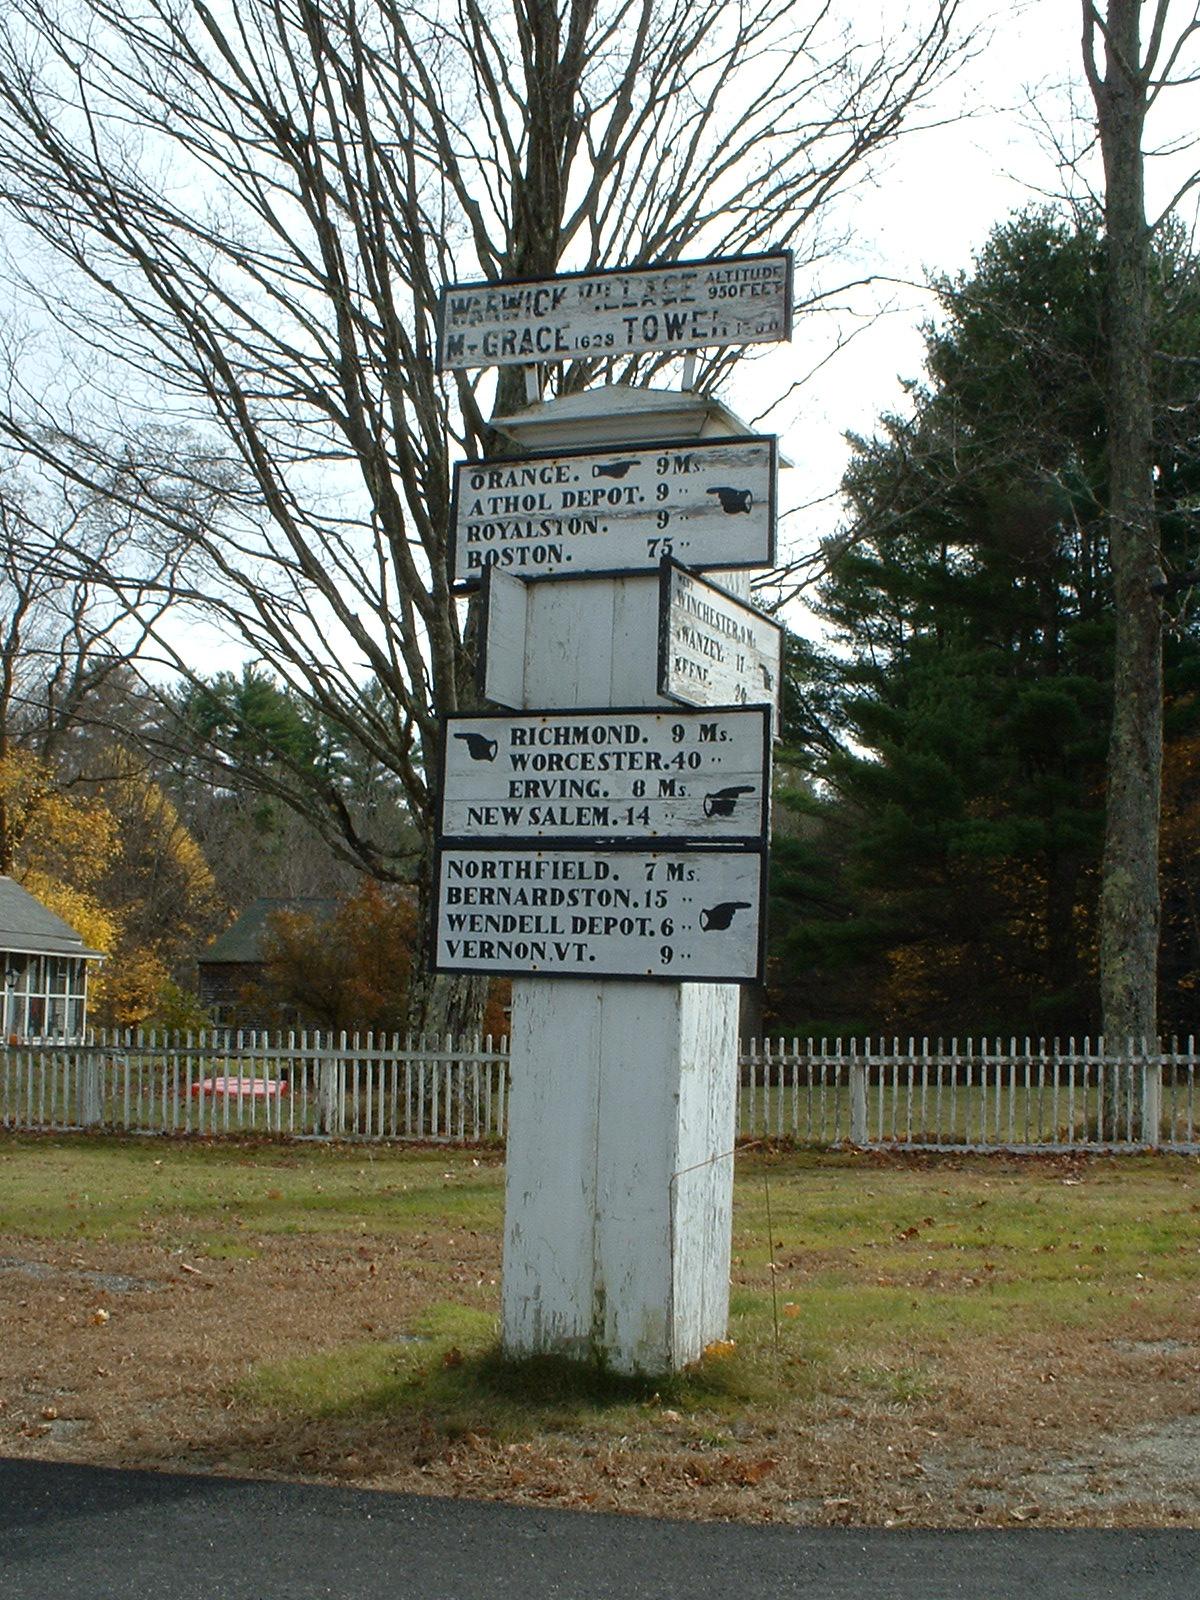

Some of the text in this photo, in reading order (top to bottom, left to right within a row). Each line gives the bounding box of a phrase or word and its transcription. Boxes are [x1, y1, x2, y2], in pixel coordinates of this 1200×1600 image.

[705, 265, 782, 284] ALTITUDE
[708, 284, 738, 300] 950
[470, 464, 580, 490] ORANGE.
[656, 456, 669, 475] 9
[468, 483, 669, 516] ATHOL DEPOT. 9
[467, 510, 669, 543] ROYALSTON. 9
[467, 538, 673, 570] BOSTON. 75
[510, 724, 648, 746] RICHMOND.
[672, 724, 685, 744] 9
[508, 780, 609, 798] ERVING.
[632, 779, 645, 797] 8
[467, 806, 650, 826] NEW SALEM. 14
[447, 860, 619, 882] NORTHFIELD.
[645, 863, 657, 882] 7
[447, 887, 668, 909] BERNARDSTON. 15
[446, 914, 674, 937] WENDELL DEPOT. 6
[660, 946, 673, 965] 9
